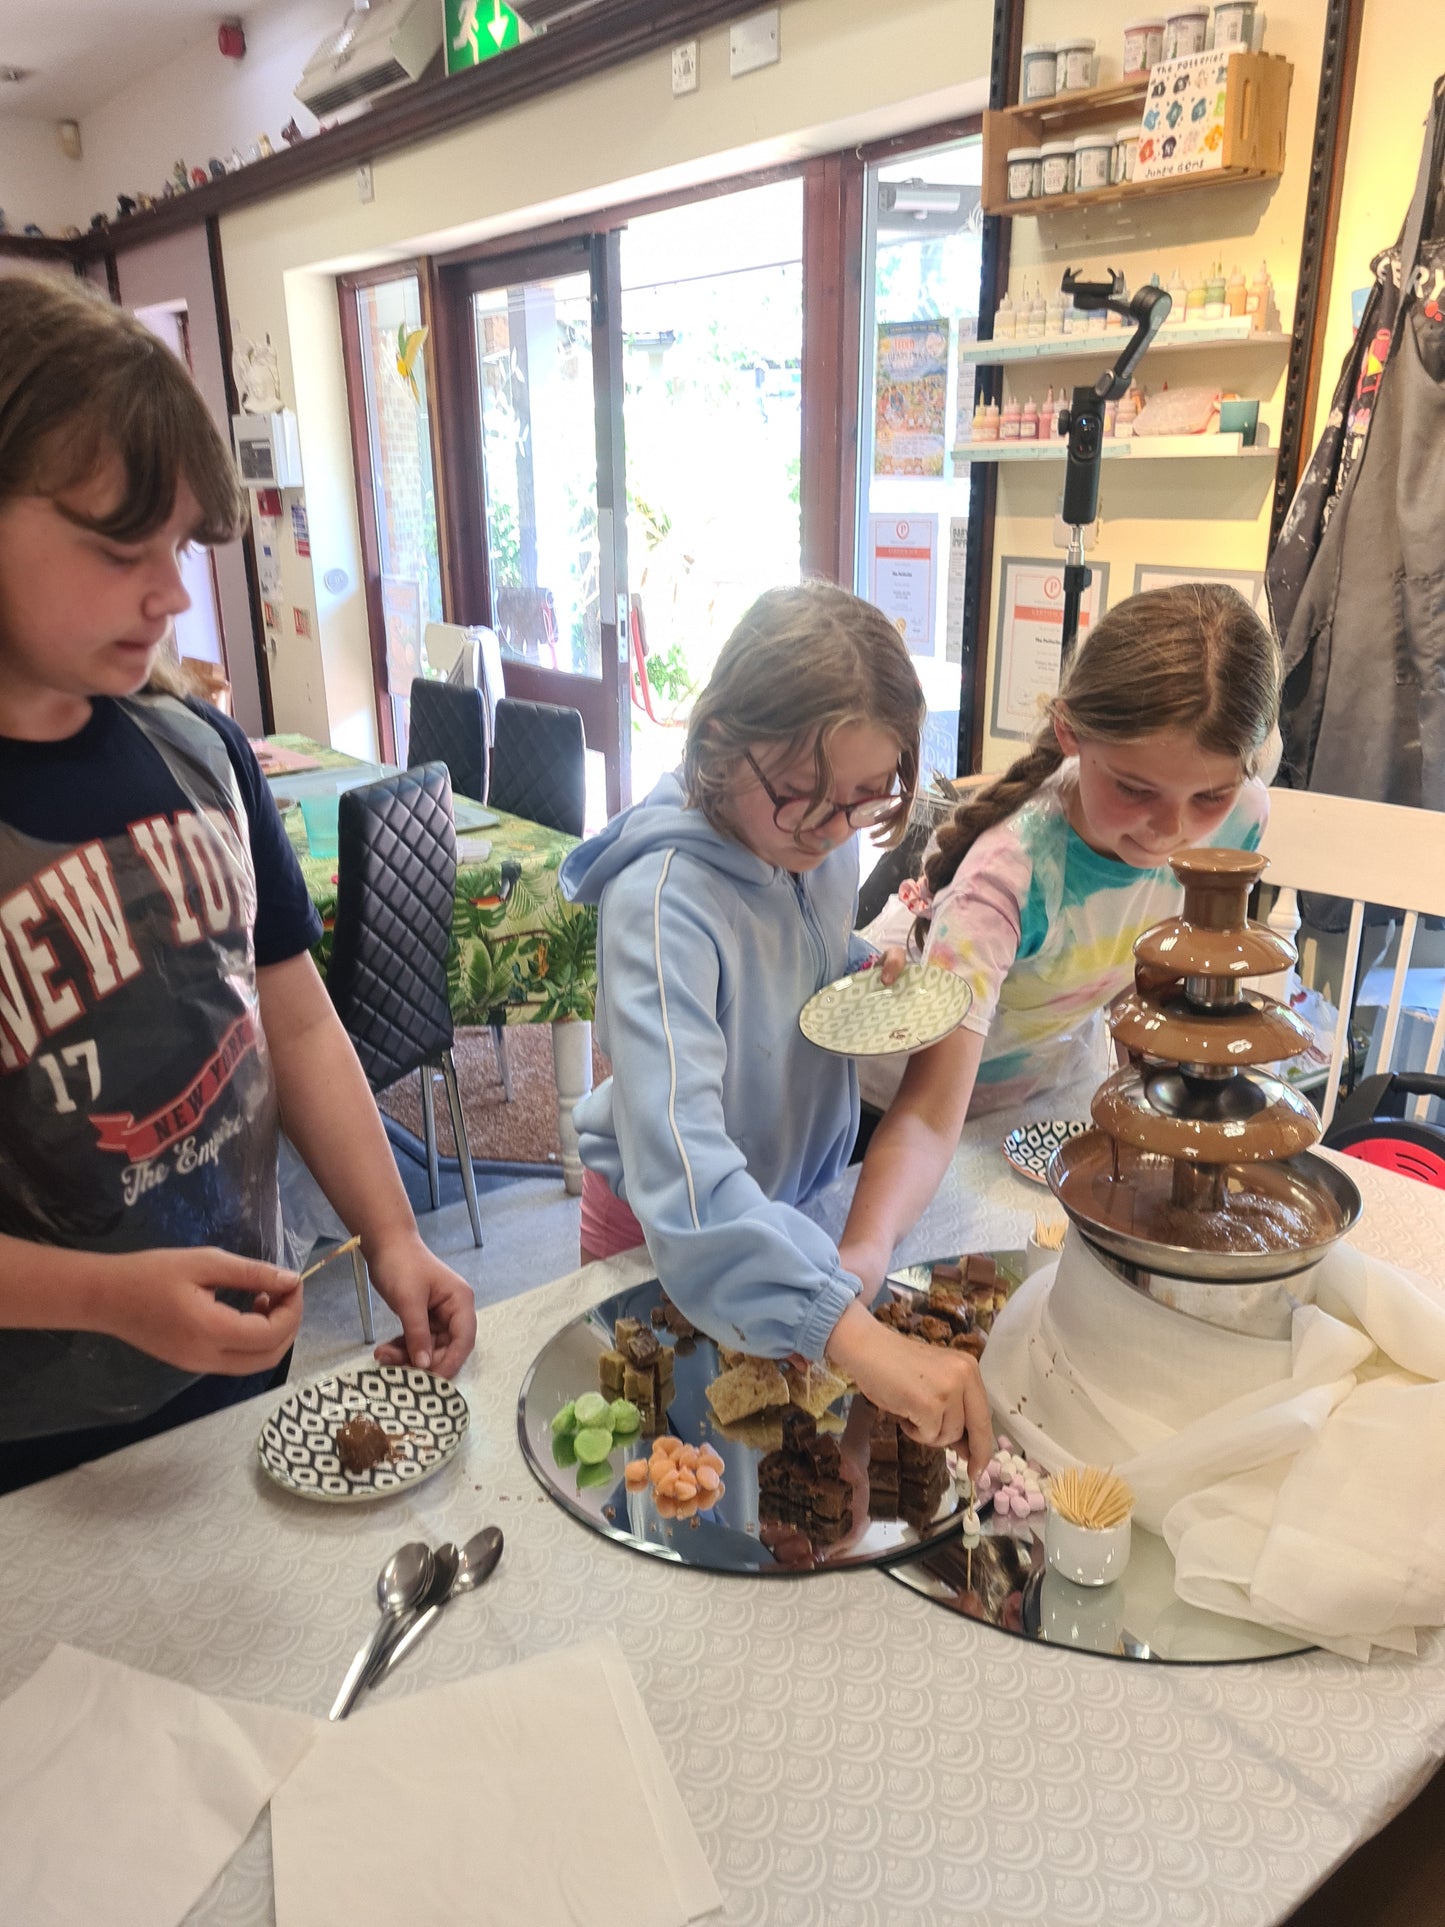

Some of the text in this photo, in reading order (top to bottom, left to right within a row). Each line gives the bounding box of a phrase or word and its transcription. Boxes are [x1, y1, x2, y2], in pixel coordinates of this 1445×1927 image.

[38, 1038, 102, 1114] 17
[152, 1082, 203, 1143] NEW
[121, 1160, 170, 1207] The
